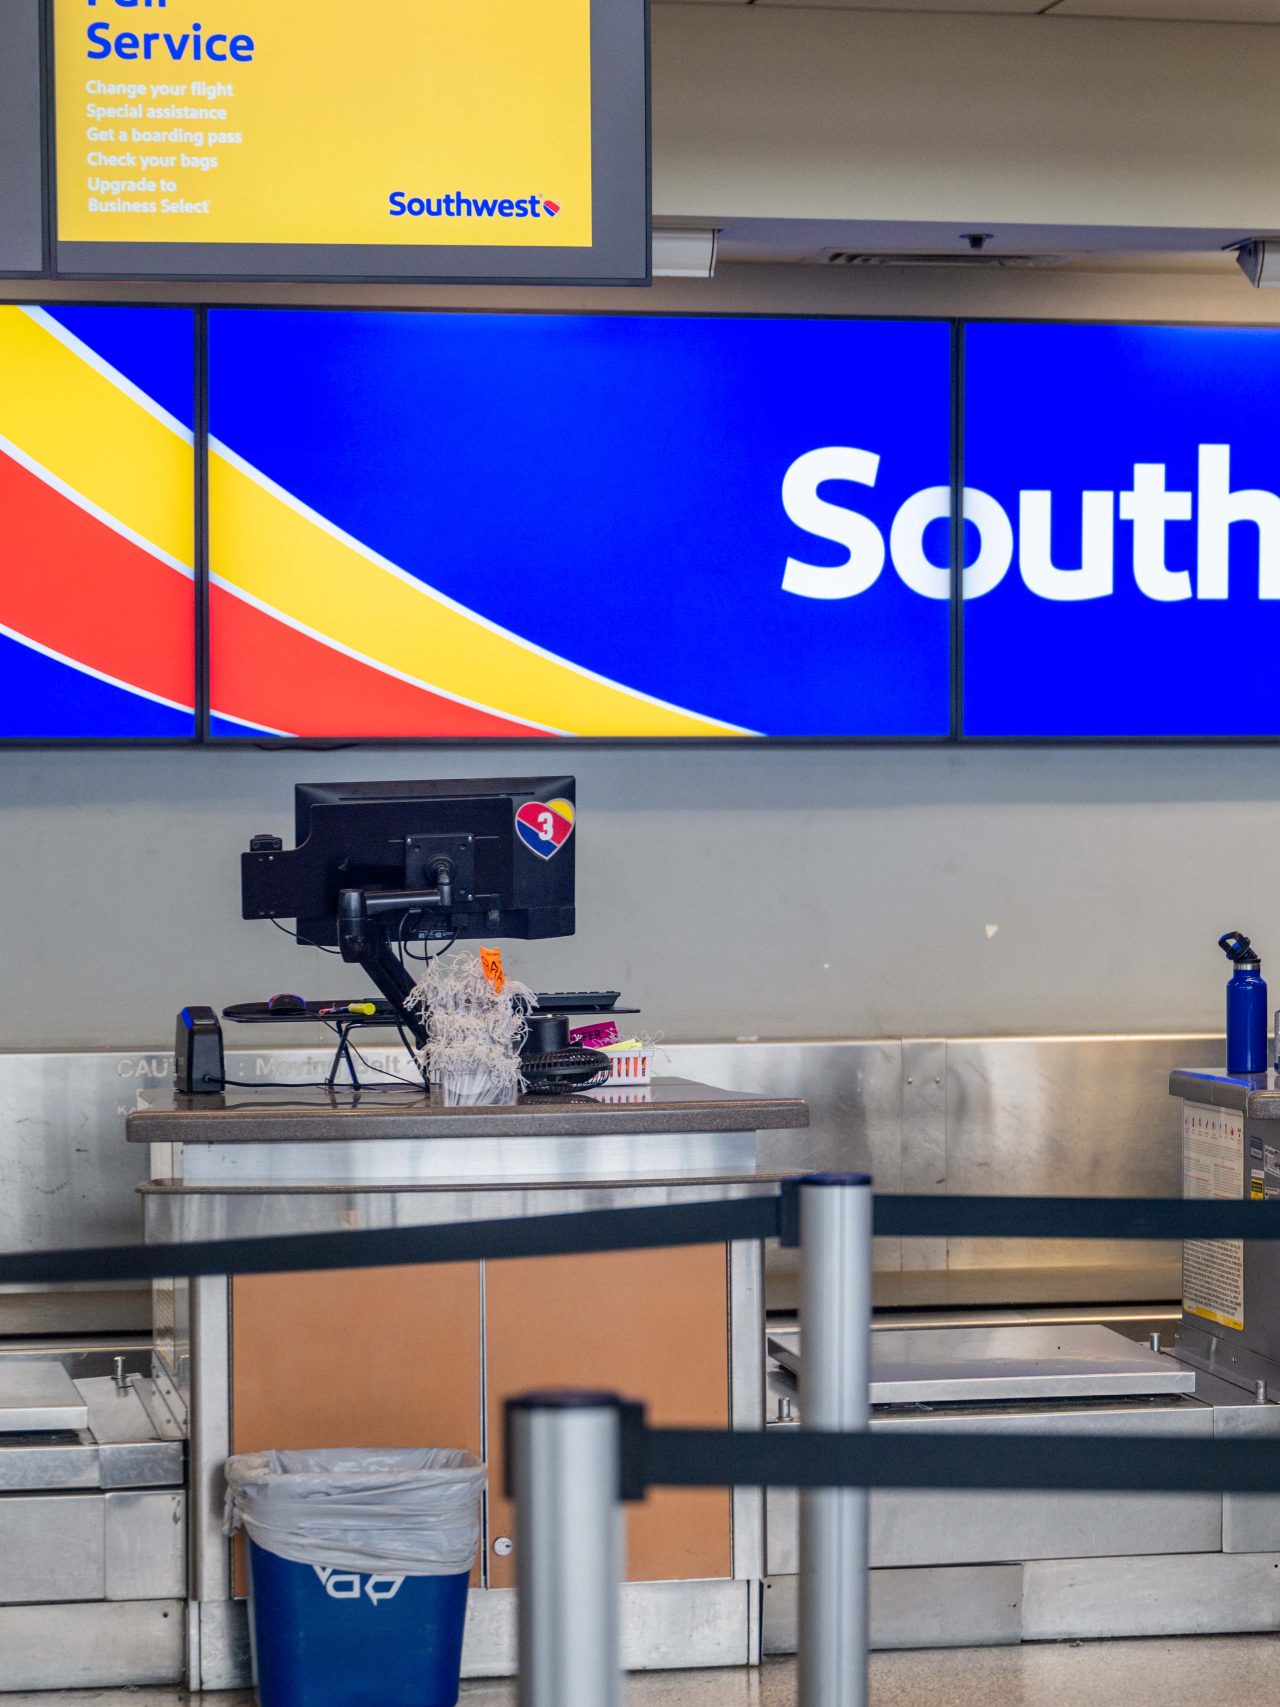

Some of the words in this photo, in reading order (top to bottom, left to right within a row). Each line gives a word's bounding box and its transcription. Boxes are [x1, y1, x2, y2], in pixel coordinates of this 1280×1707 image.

[87, 22, 255, 62] Service
[85, 80, 146, 99] Change
[150, 83, 187, 99] your
[191, 82, 233, 100] flight
[86, 104, 142, 121] Special
[147, 105, 227, 121] assistance
[86, 127, 114, 142] Get
[118, 131, 127, 142] a
[132, 128, 204, 146] boarding
[208, 132, 242, 146] pass
[87, 152, 136, 166] Check
[140, 156, 177, 170] your
[181, 153, 218, 171] bags
[88, 177, 156, 195] Upgrade
[160, 179, 177, 192] to
[88, 199, 156, 213] Business
[389, 191, 540, 217] Southwest
[538, 812, 553, 840] 3
